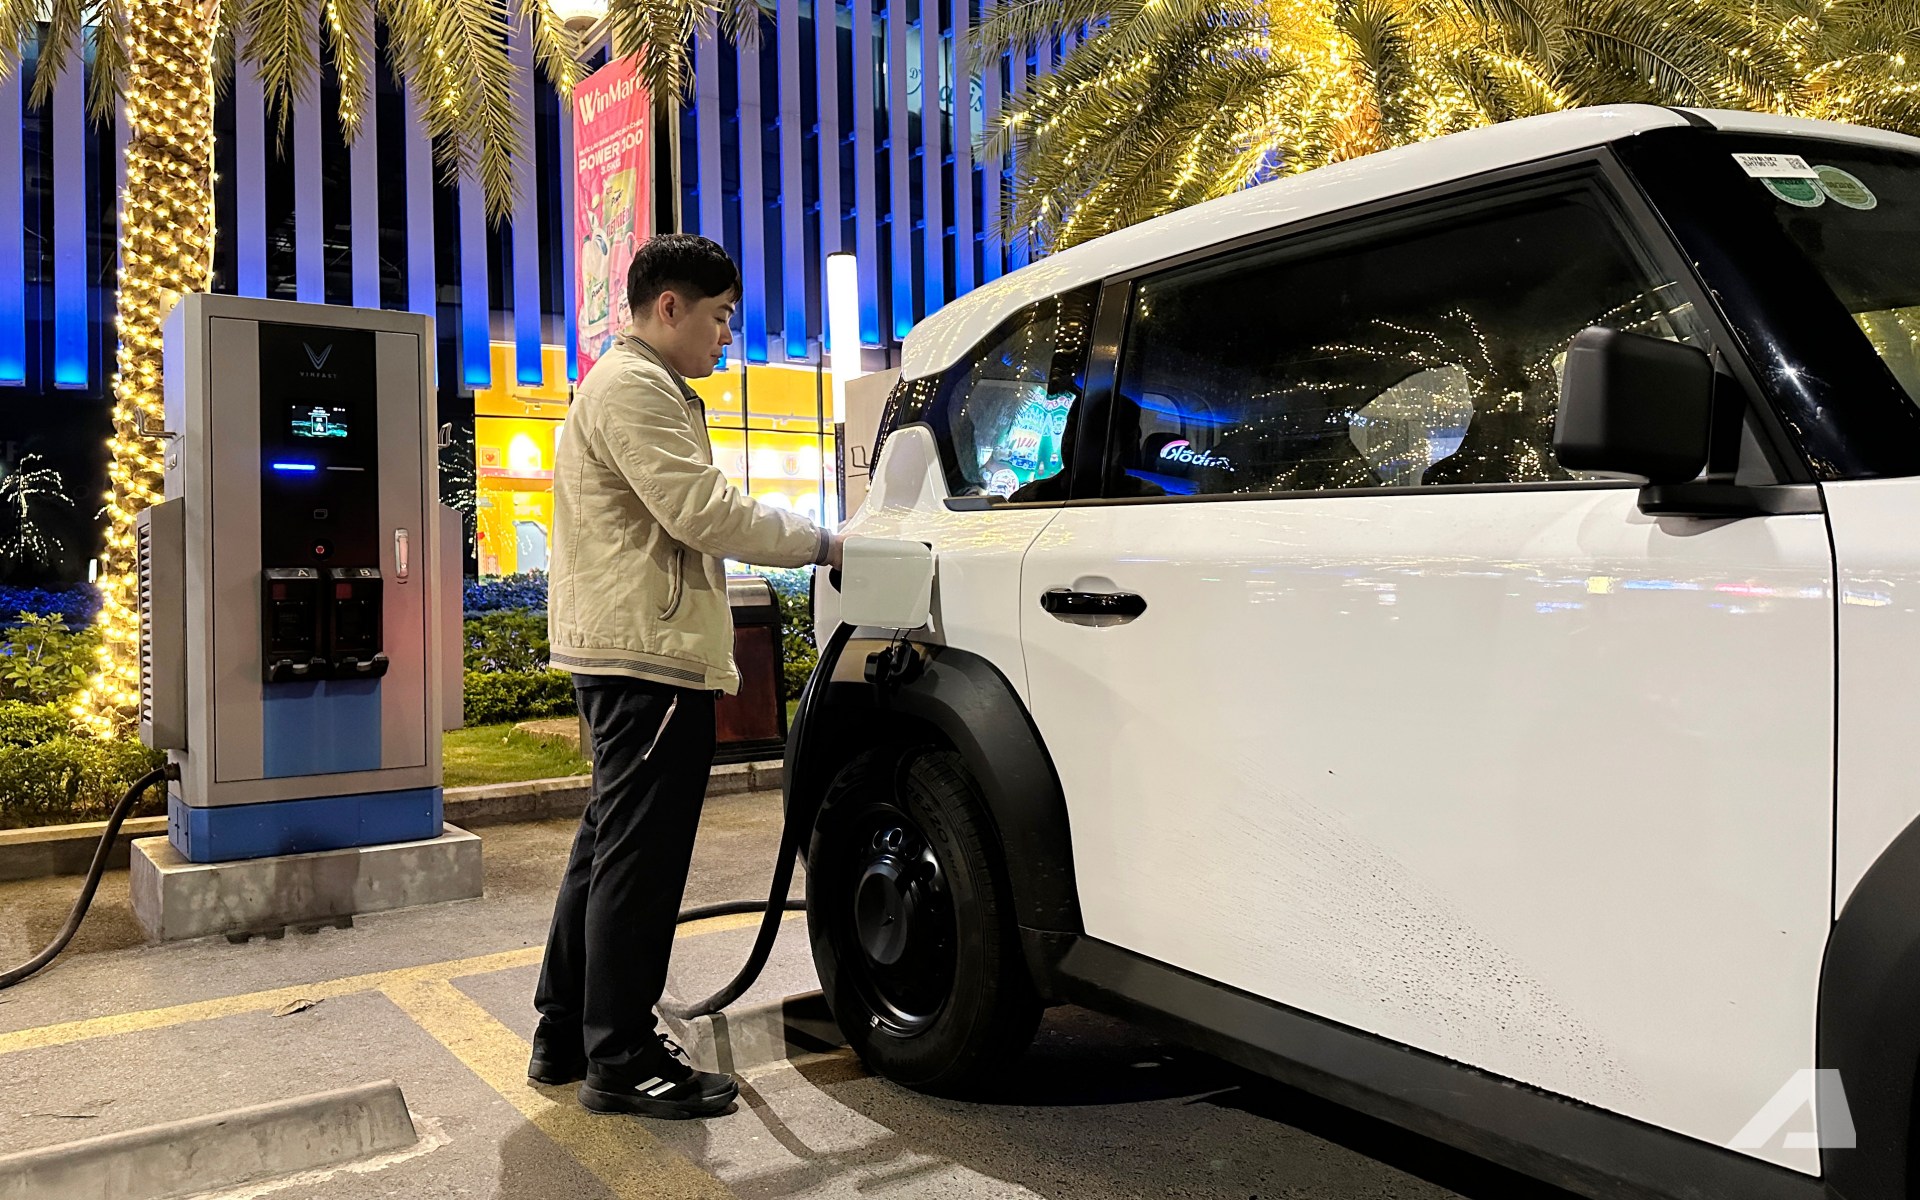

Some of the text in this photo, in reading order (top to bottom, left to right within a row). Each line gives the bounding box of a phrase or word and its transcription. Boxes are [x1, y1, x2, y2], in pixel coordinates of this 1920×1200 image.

[579, 68, 642, 126] WinMart
[579, 128, 644, 174] POWER 100
[298, 569, 308, 577] A
[360, 569, 371, 577] B
